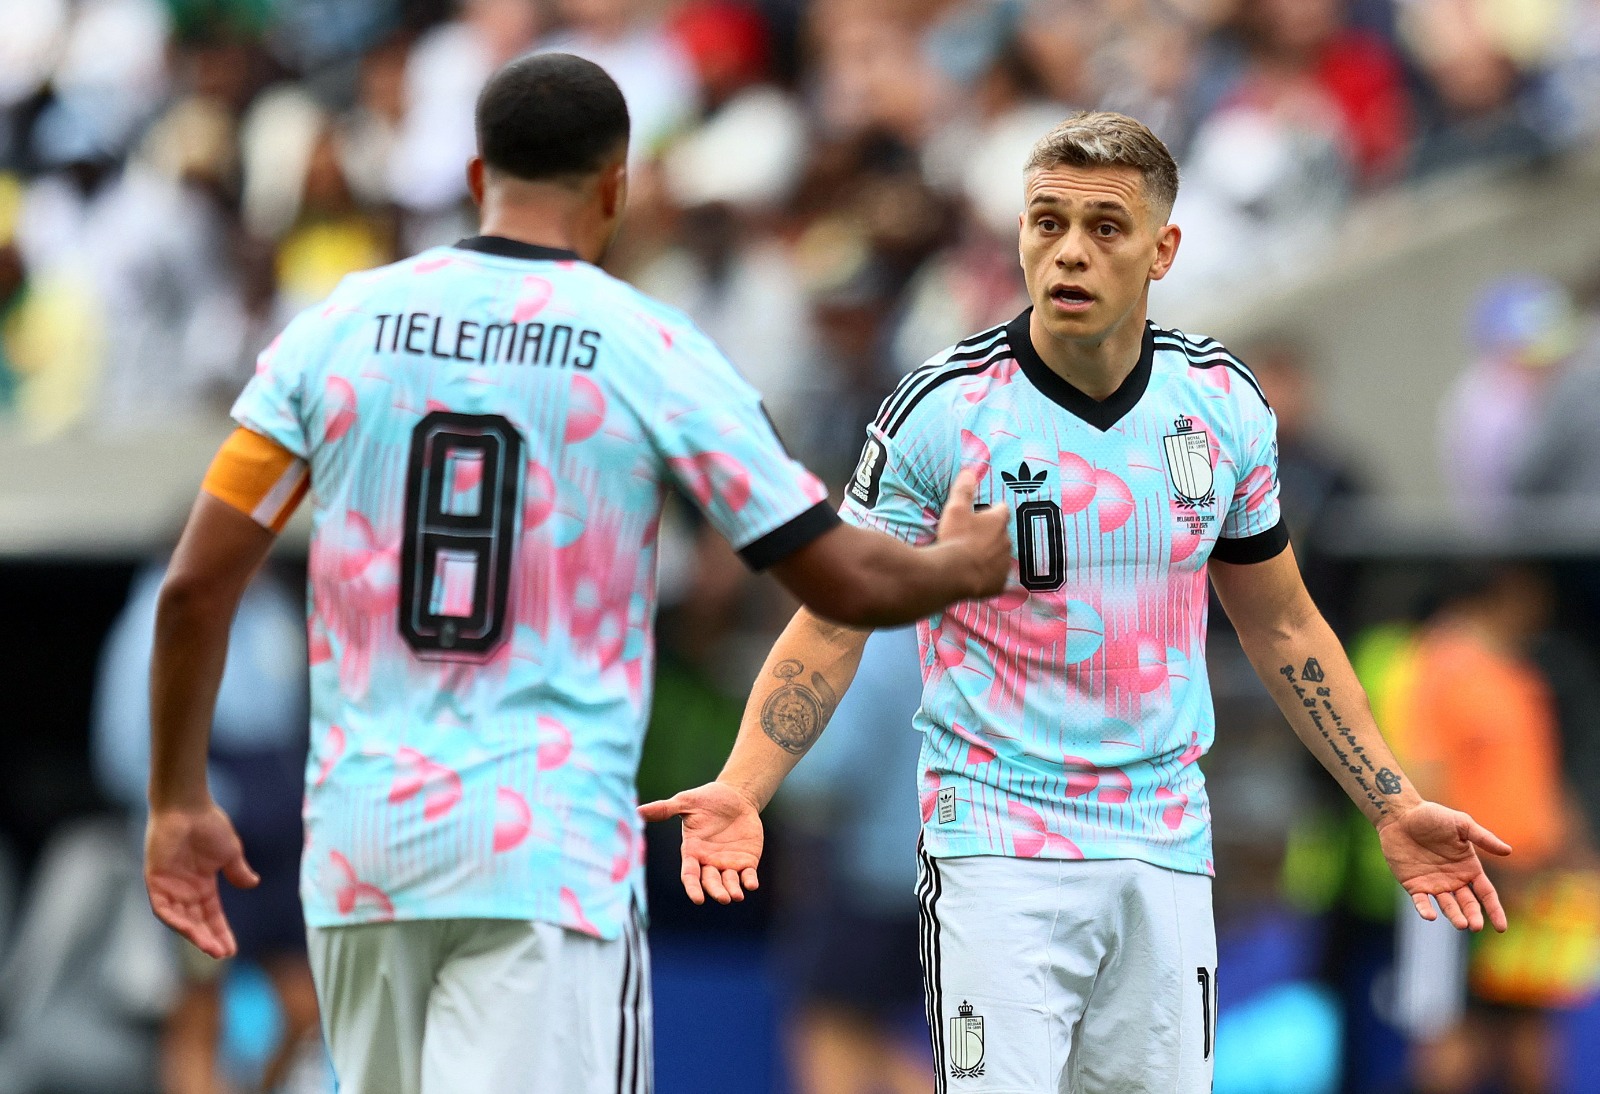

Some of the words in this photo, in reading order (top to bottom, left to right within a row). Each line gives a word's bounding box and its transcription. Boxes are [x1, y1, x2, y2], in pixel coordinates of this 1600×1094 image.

[375, 312, 602, 370] TIELEMANS
[398, 411, 525, 664] 8
[974, 500, 1067, 593] 0
[1197, 967, 1217, 1062] 1
